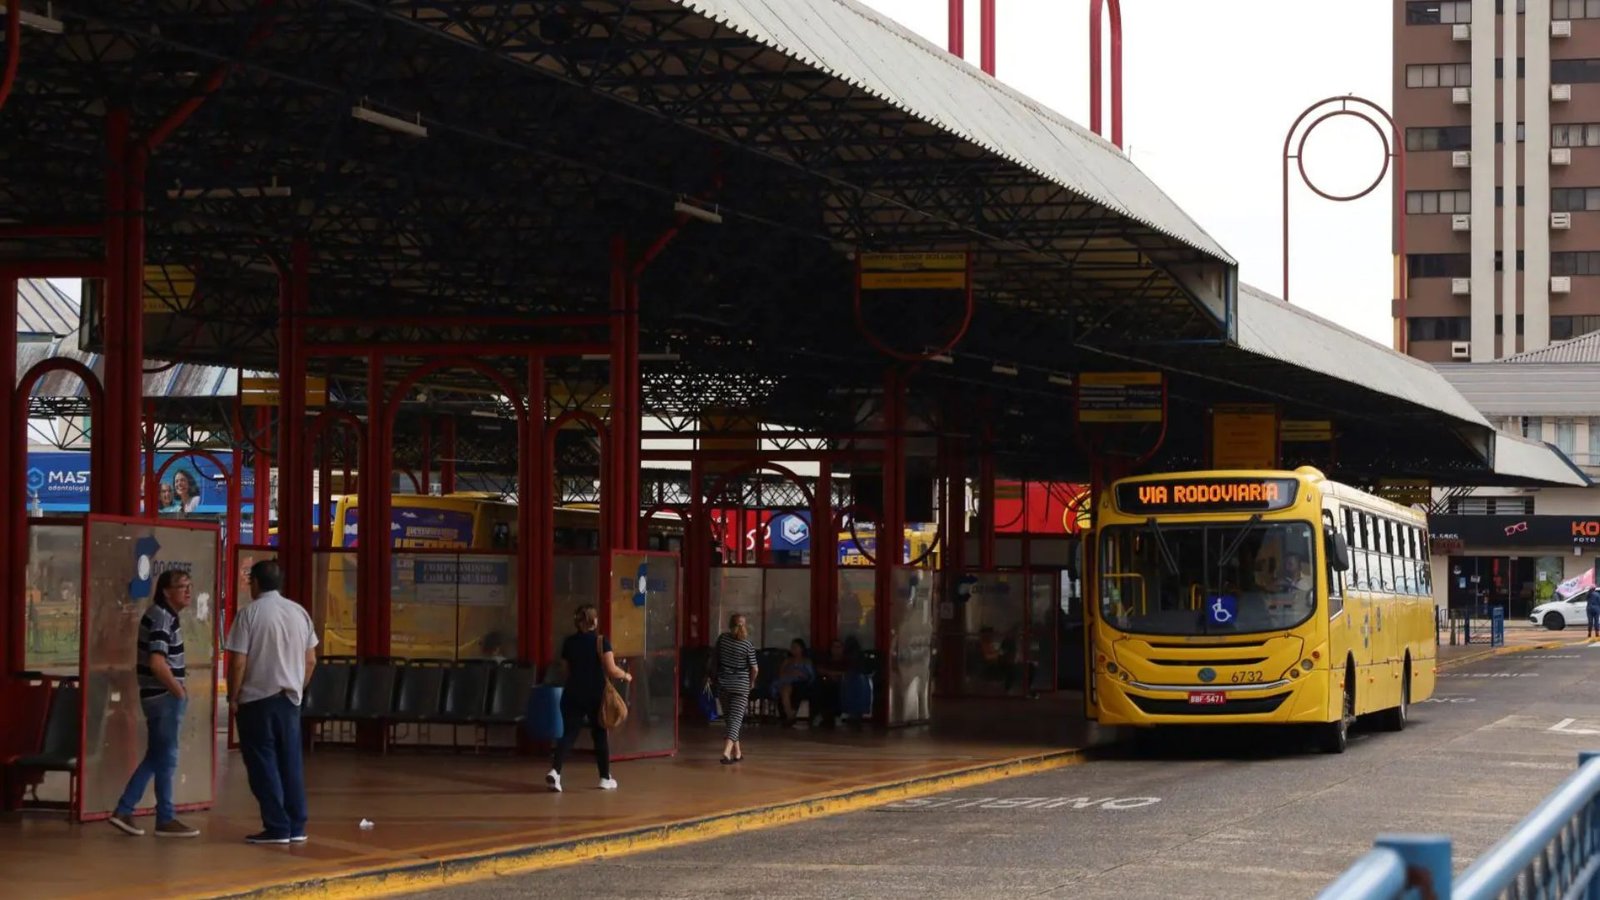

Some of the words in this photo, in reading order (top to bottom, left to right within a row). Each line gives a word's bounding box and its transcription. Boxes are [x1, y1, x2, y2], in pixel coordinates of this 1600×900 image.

[1139, 486, 1167, 504] VIA
[1174, 483, 1279, 503] RODOVIARIA
[1231, 671, 1263, 683] 6732
